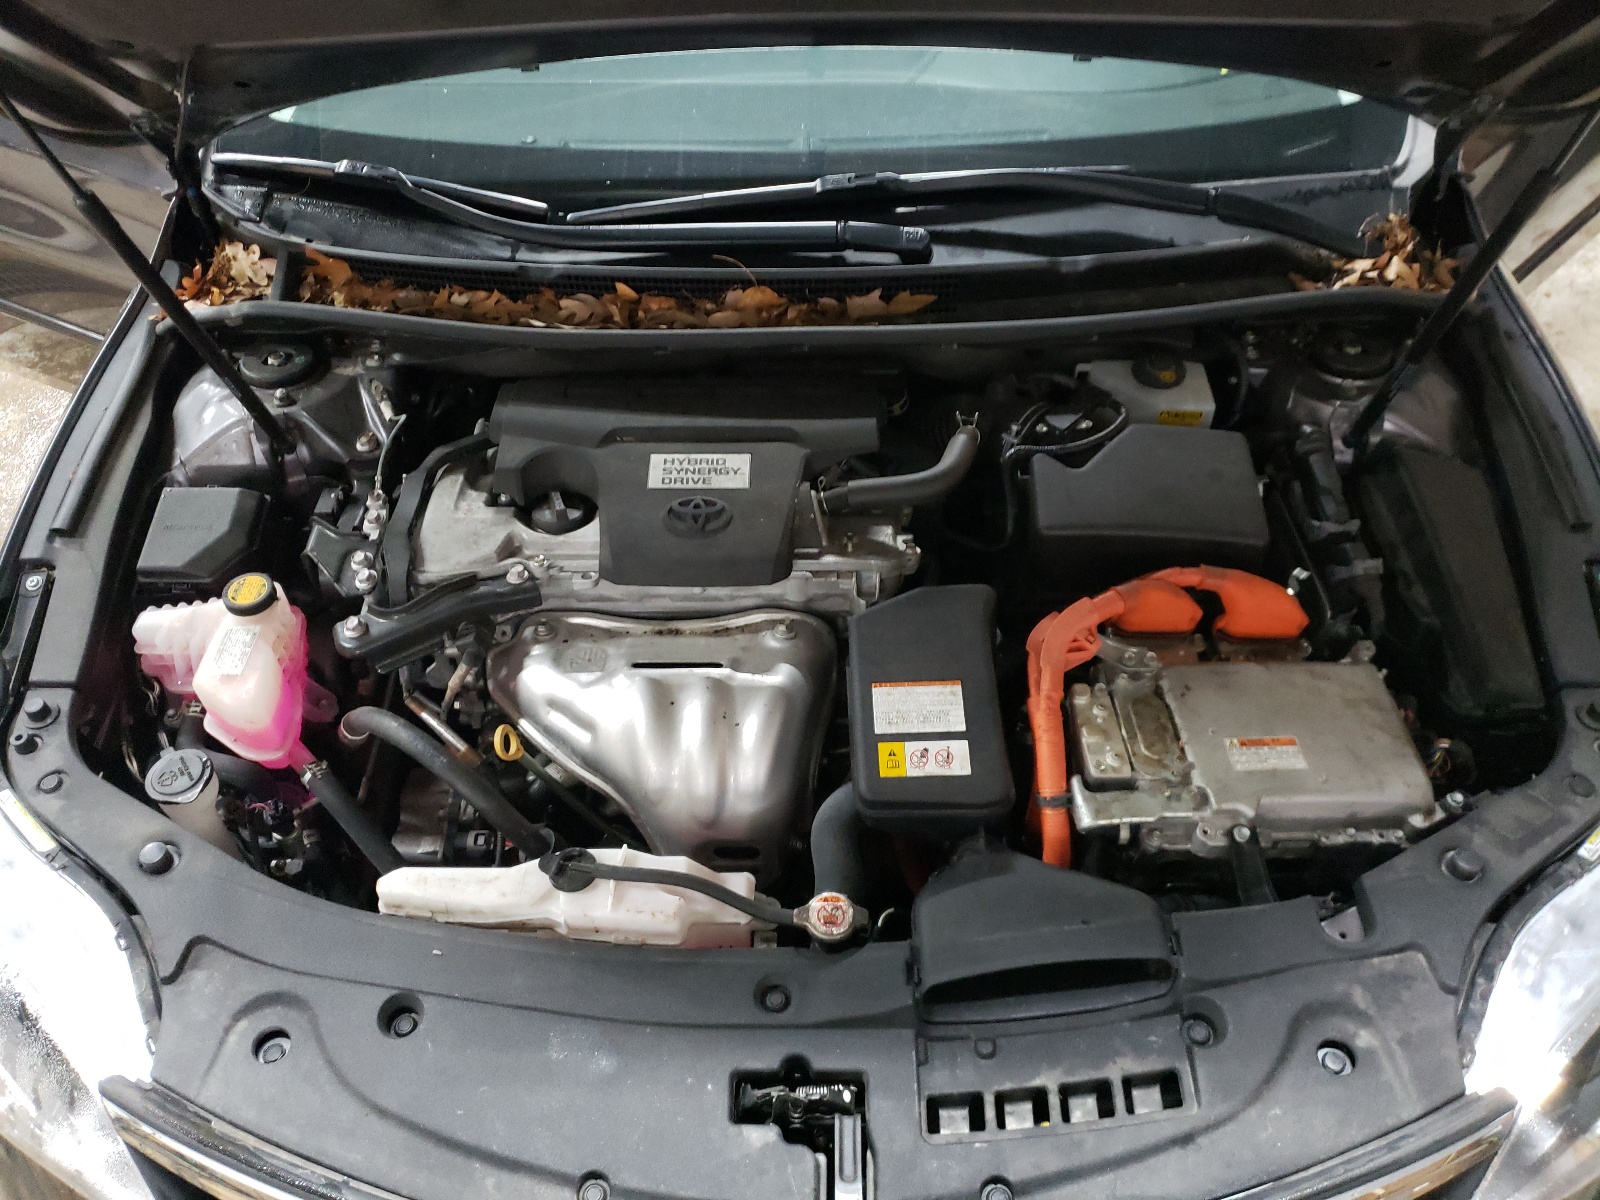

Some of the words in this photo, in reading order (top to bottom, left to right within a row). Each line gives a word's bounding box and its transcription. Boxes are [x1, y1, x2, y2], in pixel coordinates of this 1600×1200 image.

[663, 457, 727, 466] HYBRID
[662, 466, 741, 476] SYNERGY
[661, 476, 713, 485] DRIVE
